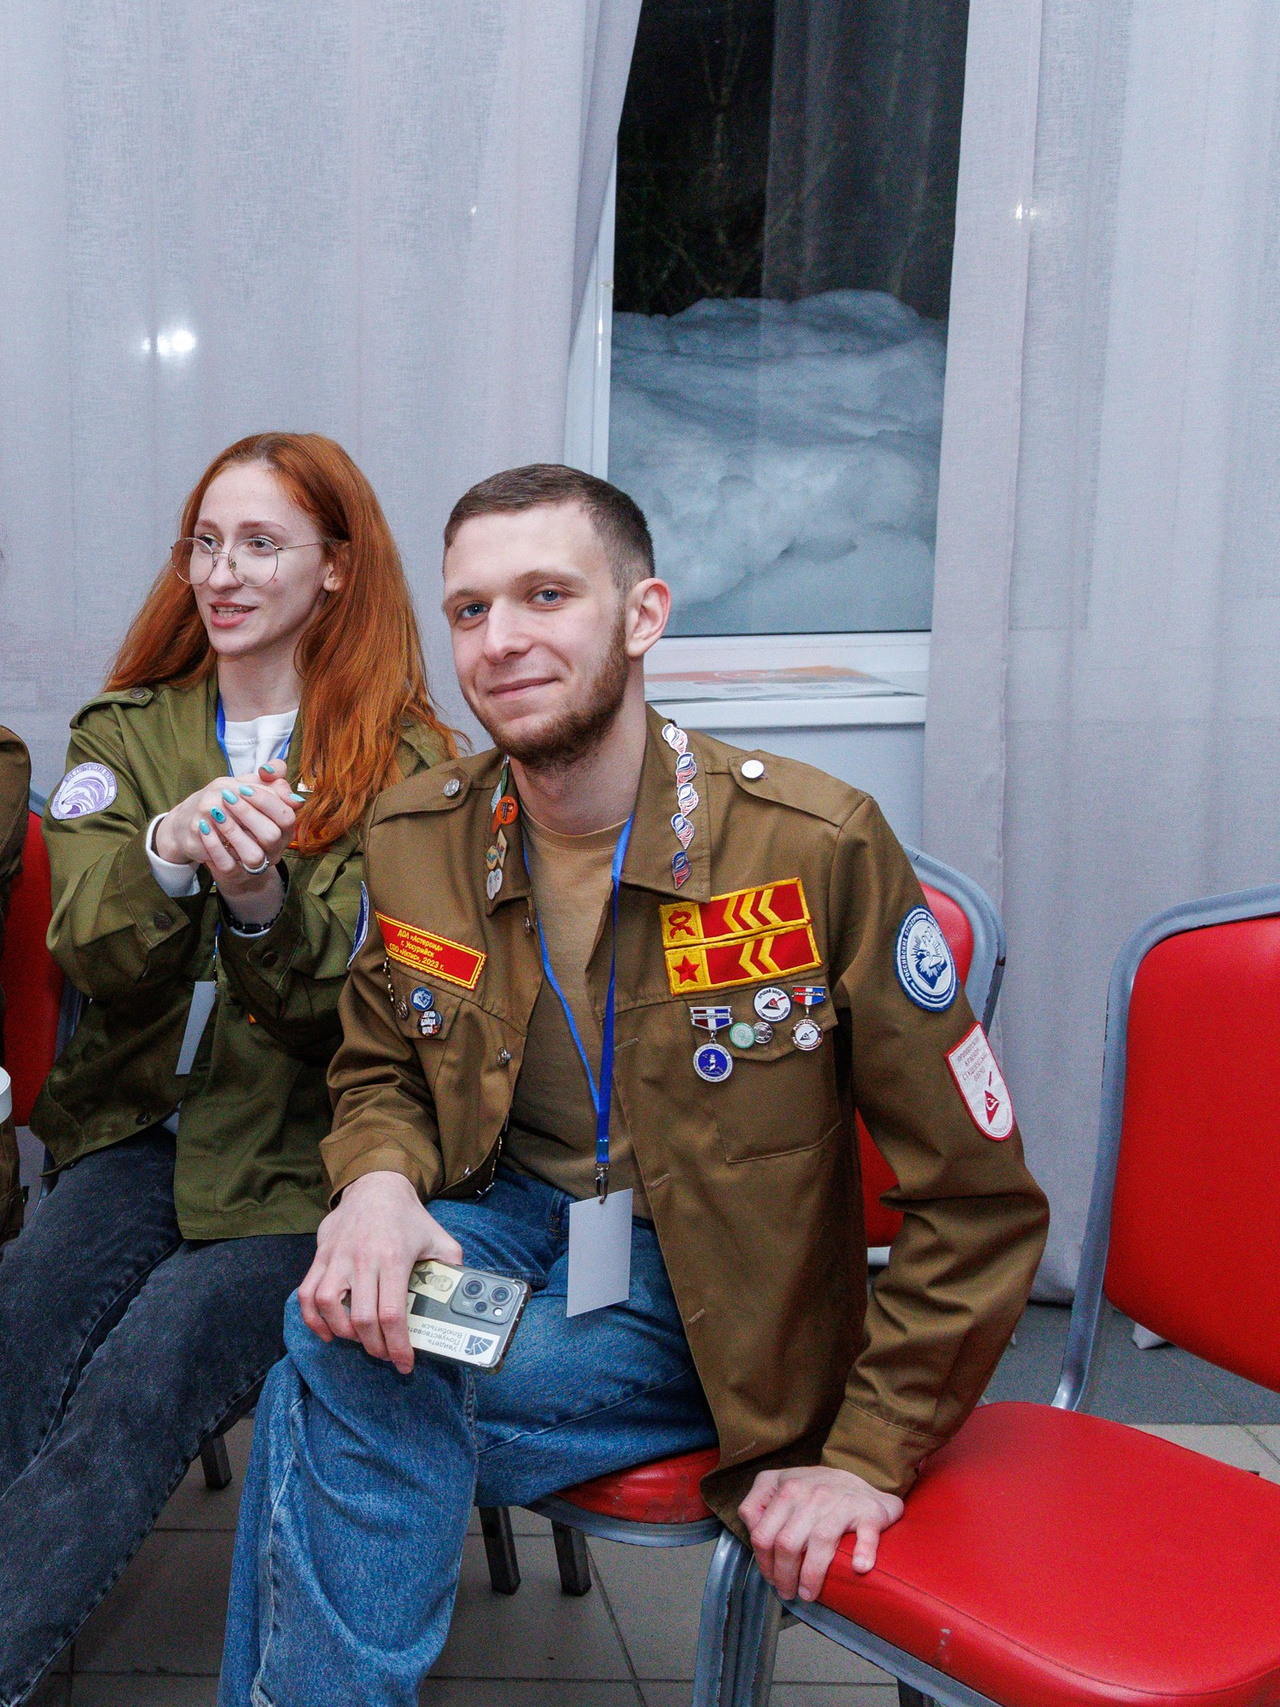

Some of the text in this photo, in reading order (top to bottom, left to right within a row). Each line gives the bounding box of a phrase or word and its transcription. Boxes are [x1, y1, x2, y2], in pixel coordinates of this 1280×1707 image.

[405, 940, 435, 958] Уссурийск
[422, 956, 440, 969] 2023
[422, 1323, 463, 1339] Влюбиться
[428, 1339, 458, 1352] Увидеть
